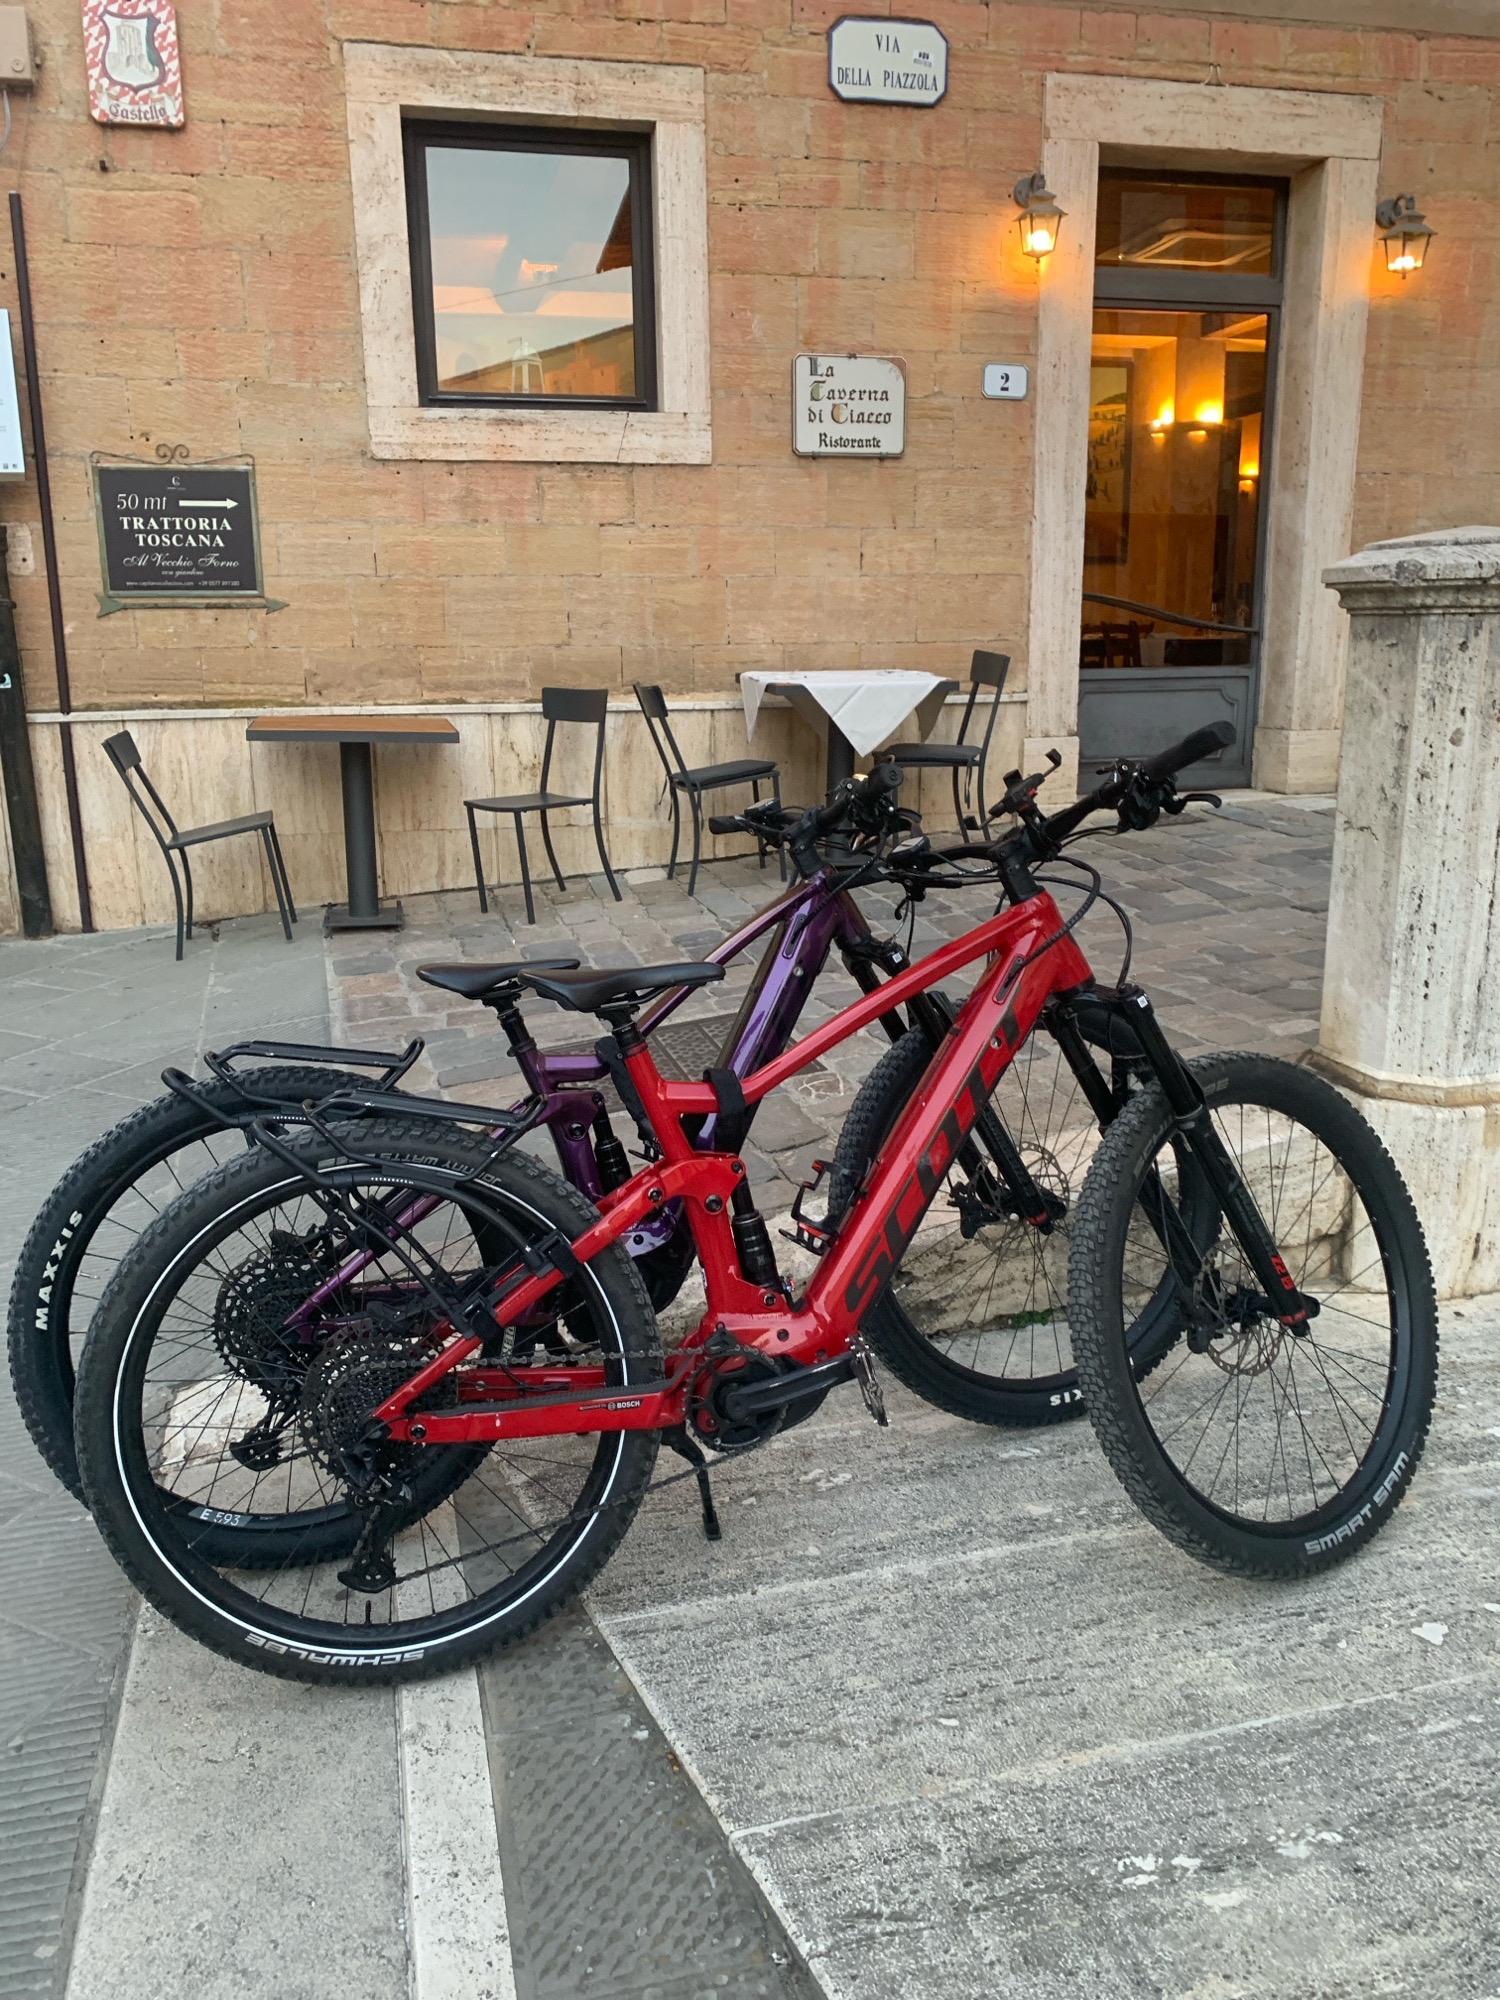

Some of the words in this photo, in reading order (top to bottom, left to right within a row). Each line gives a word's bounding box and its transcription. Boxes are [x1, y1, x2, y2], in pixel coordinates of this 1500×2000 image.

[876, 33, 900, 54] VIA
[837, 66, 872, 87] DELLA
[883, 69, 938, 92] PIAZZOLA
[109, 102, 168, 121] Castello
[808, 356, 835, 378] La
[809, 379, 890, 402] Taverna
[1000, 372, 1010, 392] 2
[807, 406, 824, 424] di
[830, 402, 893, 425] Ciacco
[818, 432, 882, 449] Ristorante
[116, 493, 139, 510] 50
[119, 516, 233, 531] TRATTORIA
[135, 533, 226, 548] TOSCANA
[122, 552, 150, 567] Al
[150, 552, 194, 568] Vecchio
[197, 553, 240, 568] Forno
[35, 1209, 83, 1331] MAXXIS
[616, 1400, 641, 1409] BOSCH
[1304, 1502, 1372, 1556] SMART
[1373, 1450, 1410, 1508] SAM
[200, 1508, 213, 1521] E
[213, 1511, 241, 1527] 593
[244, 1632, 425, 1667] SCHWALBE
